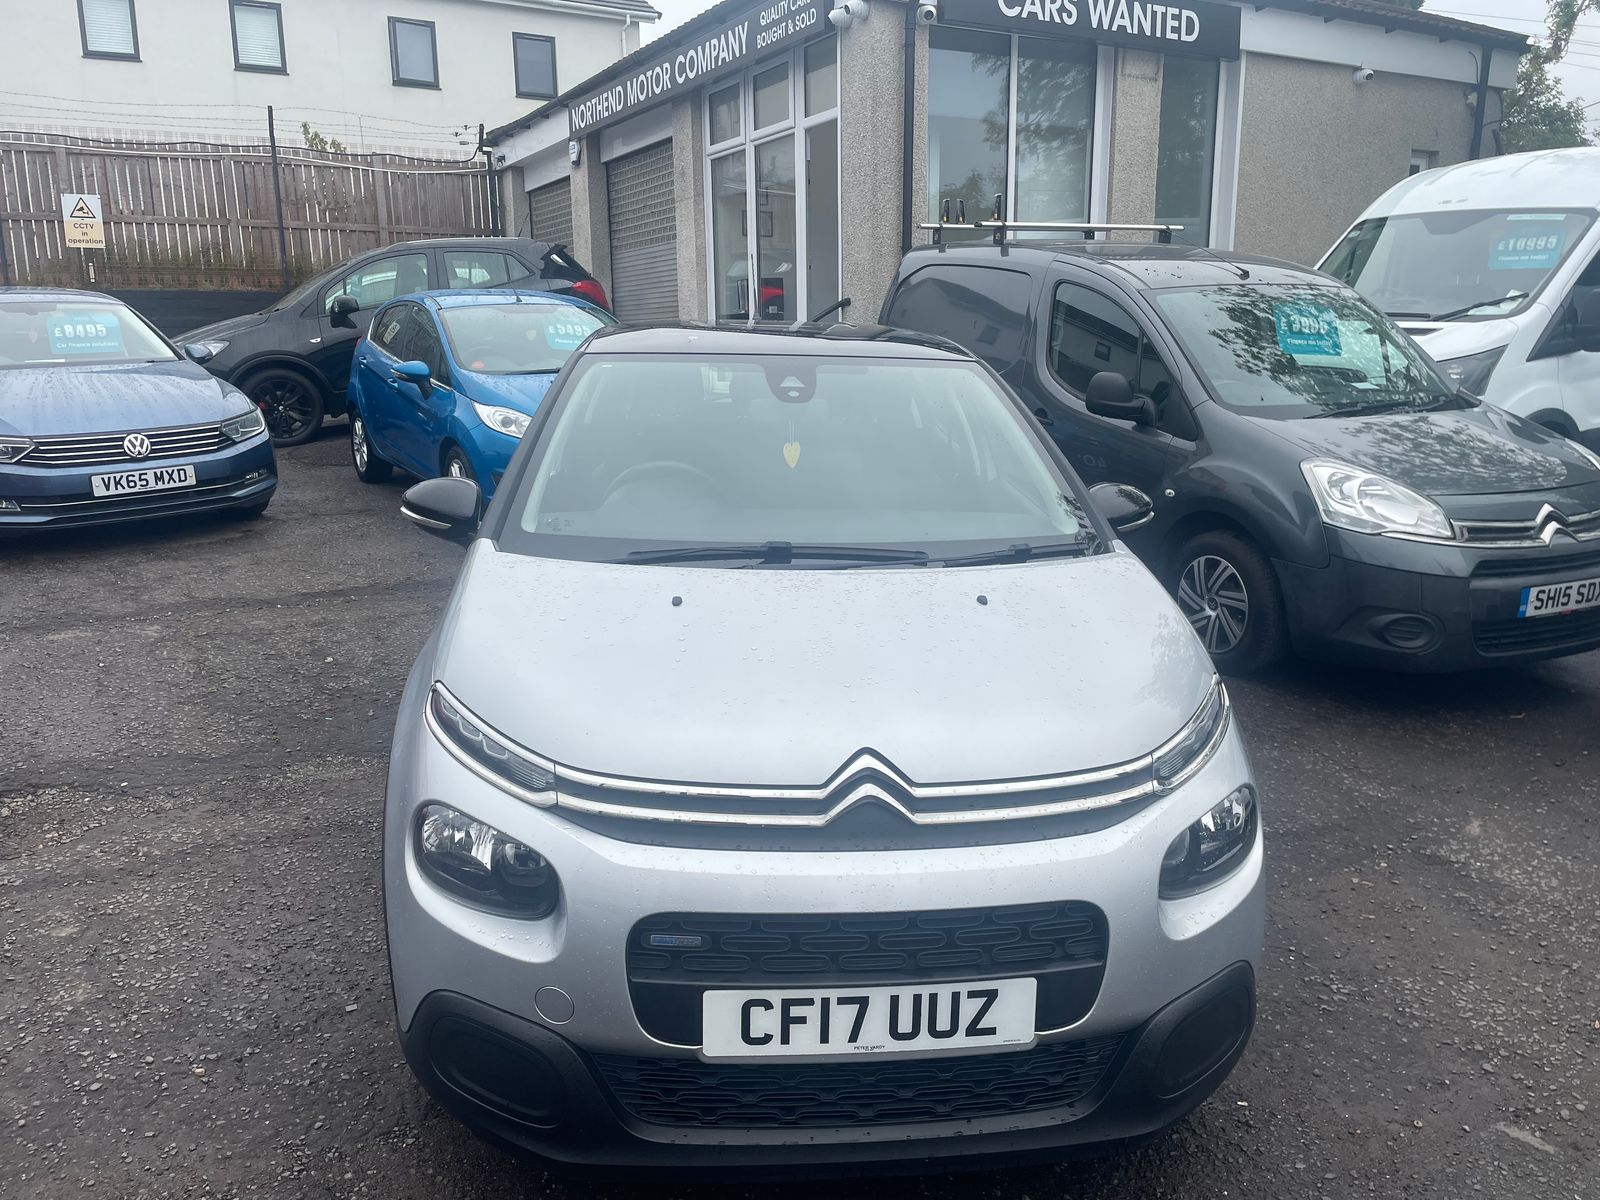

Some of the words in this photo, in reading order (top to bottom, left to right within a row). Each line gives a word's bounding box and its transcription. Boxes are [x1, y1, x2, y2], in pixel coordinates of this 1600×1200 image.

[756, 22, 786, 49] BOUGHT
[787, 19, 794, 35] &
[795, 8, 817, 31] SOLD
[760, 0, 788, 26] QUALITY
[997, 0, 1078, 26] CARS
[1087, 0, 1200, 42] WANTED
[571, 85, 624, 132] NORTHEND
[626, 62, 672, 107] MOTOR
[674, 21, 749, 84] COMPANY
[73, 222, 95, 230] CCTV
[101, 473, 150, 492] VK65
[153, 468, 188, 487] MXD
[1534, 585, 1573, 610] SH15
[740, 996, 871, 1046] CF17
[888, 988, 1000, 1042] UUZ
